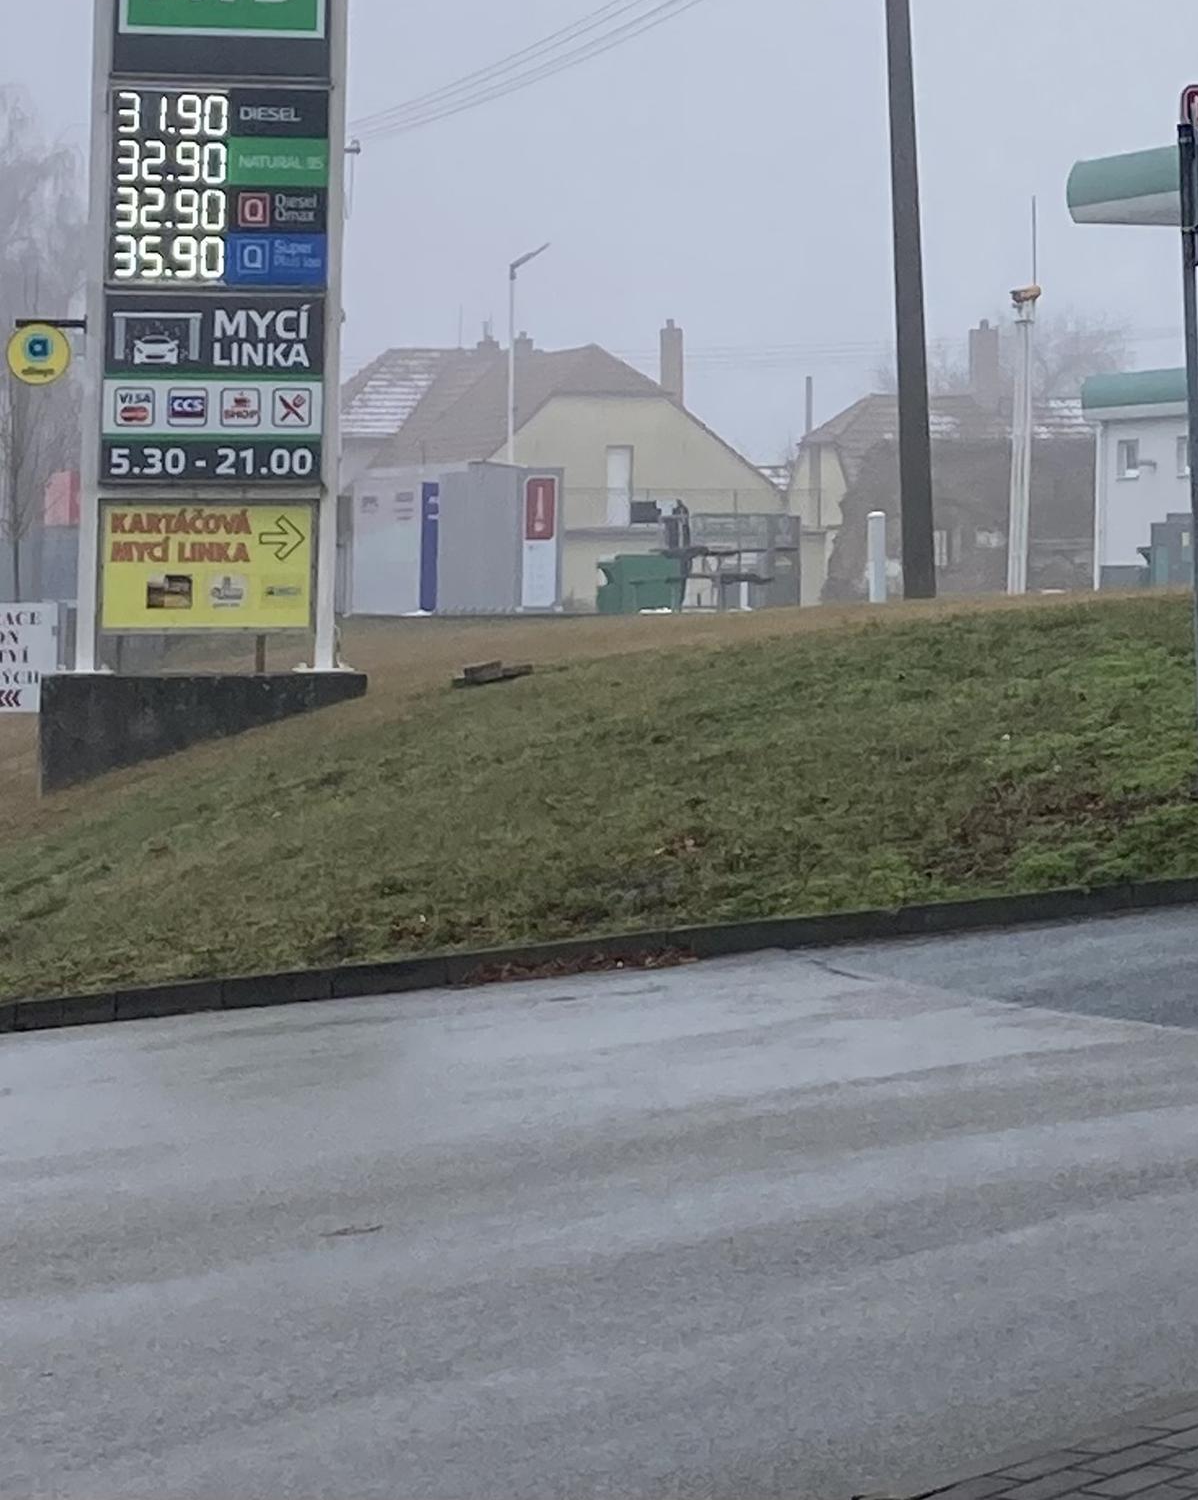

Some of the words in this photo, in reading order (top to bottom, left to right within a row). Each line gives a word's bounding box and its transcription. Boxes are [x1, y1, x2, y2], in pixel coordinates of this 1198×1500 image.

[117, 92, 228, 135] 31.90
[239, 106, 302, 121] DIESEL
[117, 139, 228, 184] 32.90
[238, 155, 301, 169] NATURAL
[116, 187, 226, 230] 32.90
[243, 198, 264, 222] Q
[274, 193, 317, 209] Diesel
[114, 235, 225, 279] 35.90
[242, 245, 263, 269] Q
[213, 304, 311, 339] MYCÍ
[212, 342, 310, 367] LINKA
[119, 392, 152, 404] VISA
[172, 399, 205, 412] CCS
[224, 409, 259, 420] SHOP
[110, 447, 186, 475] 5.30
[215, 448, 313, 476] 21.00
[111, 507, 253, 535] KARTÁČOVÁ
[111, 535, 172, 563] MYCÍ
[177, 541, 251, 563] LINKA
